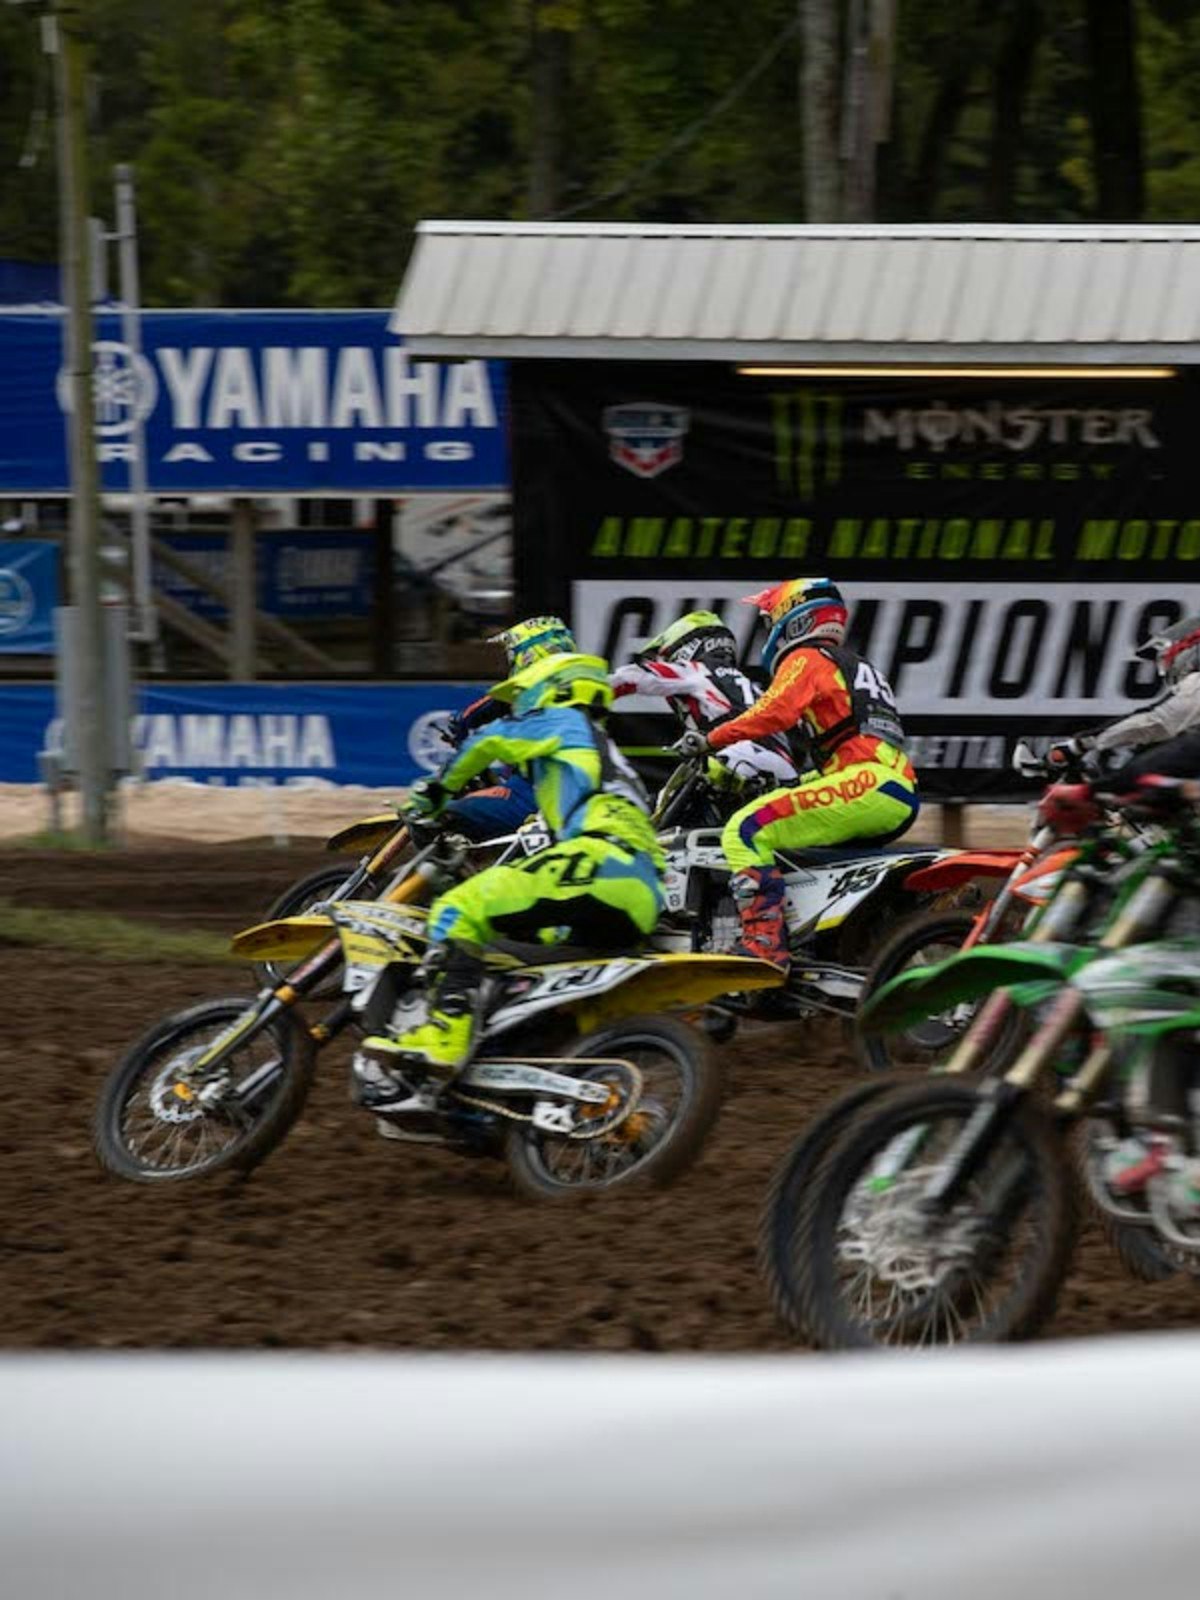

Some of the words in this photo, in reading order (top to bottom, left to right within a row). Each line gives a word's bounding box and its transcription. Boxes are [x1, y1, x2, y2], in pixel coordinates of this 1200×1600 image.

[156, 346, 497, 430] YAMAHA
[863, 405, 1162, 452] MONSTER
[97, 441, 475, 461] RACING
[906, 462, 1117, 480] ENERGY
[591, 517, 813, 558] AMATEUR
[826, 519, 1056, 559] NATIONAL
